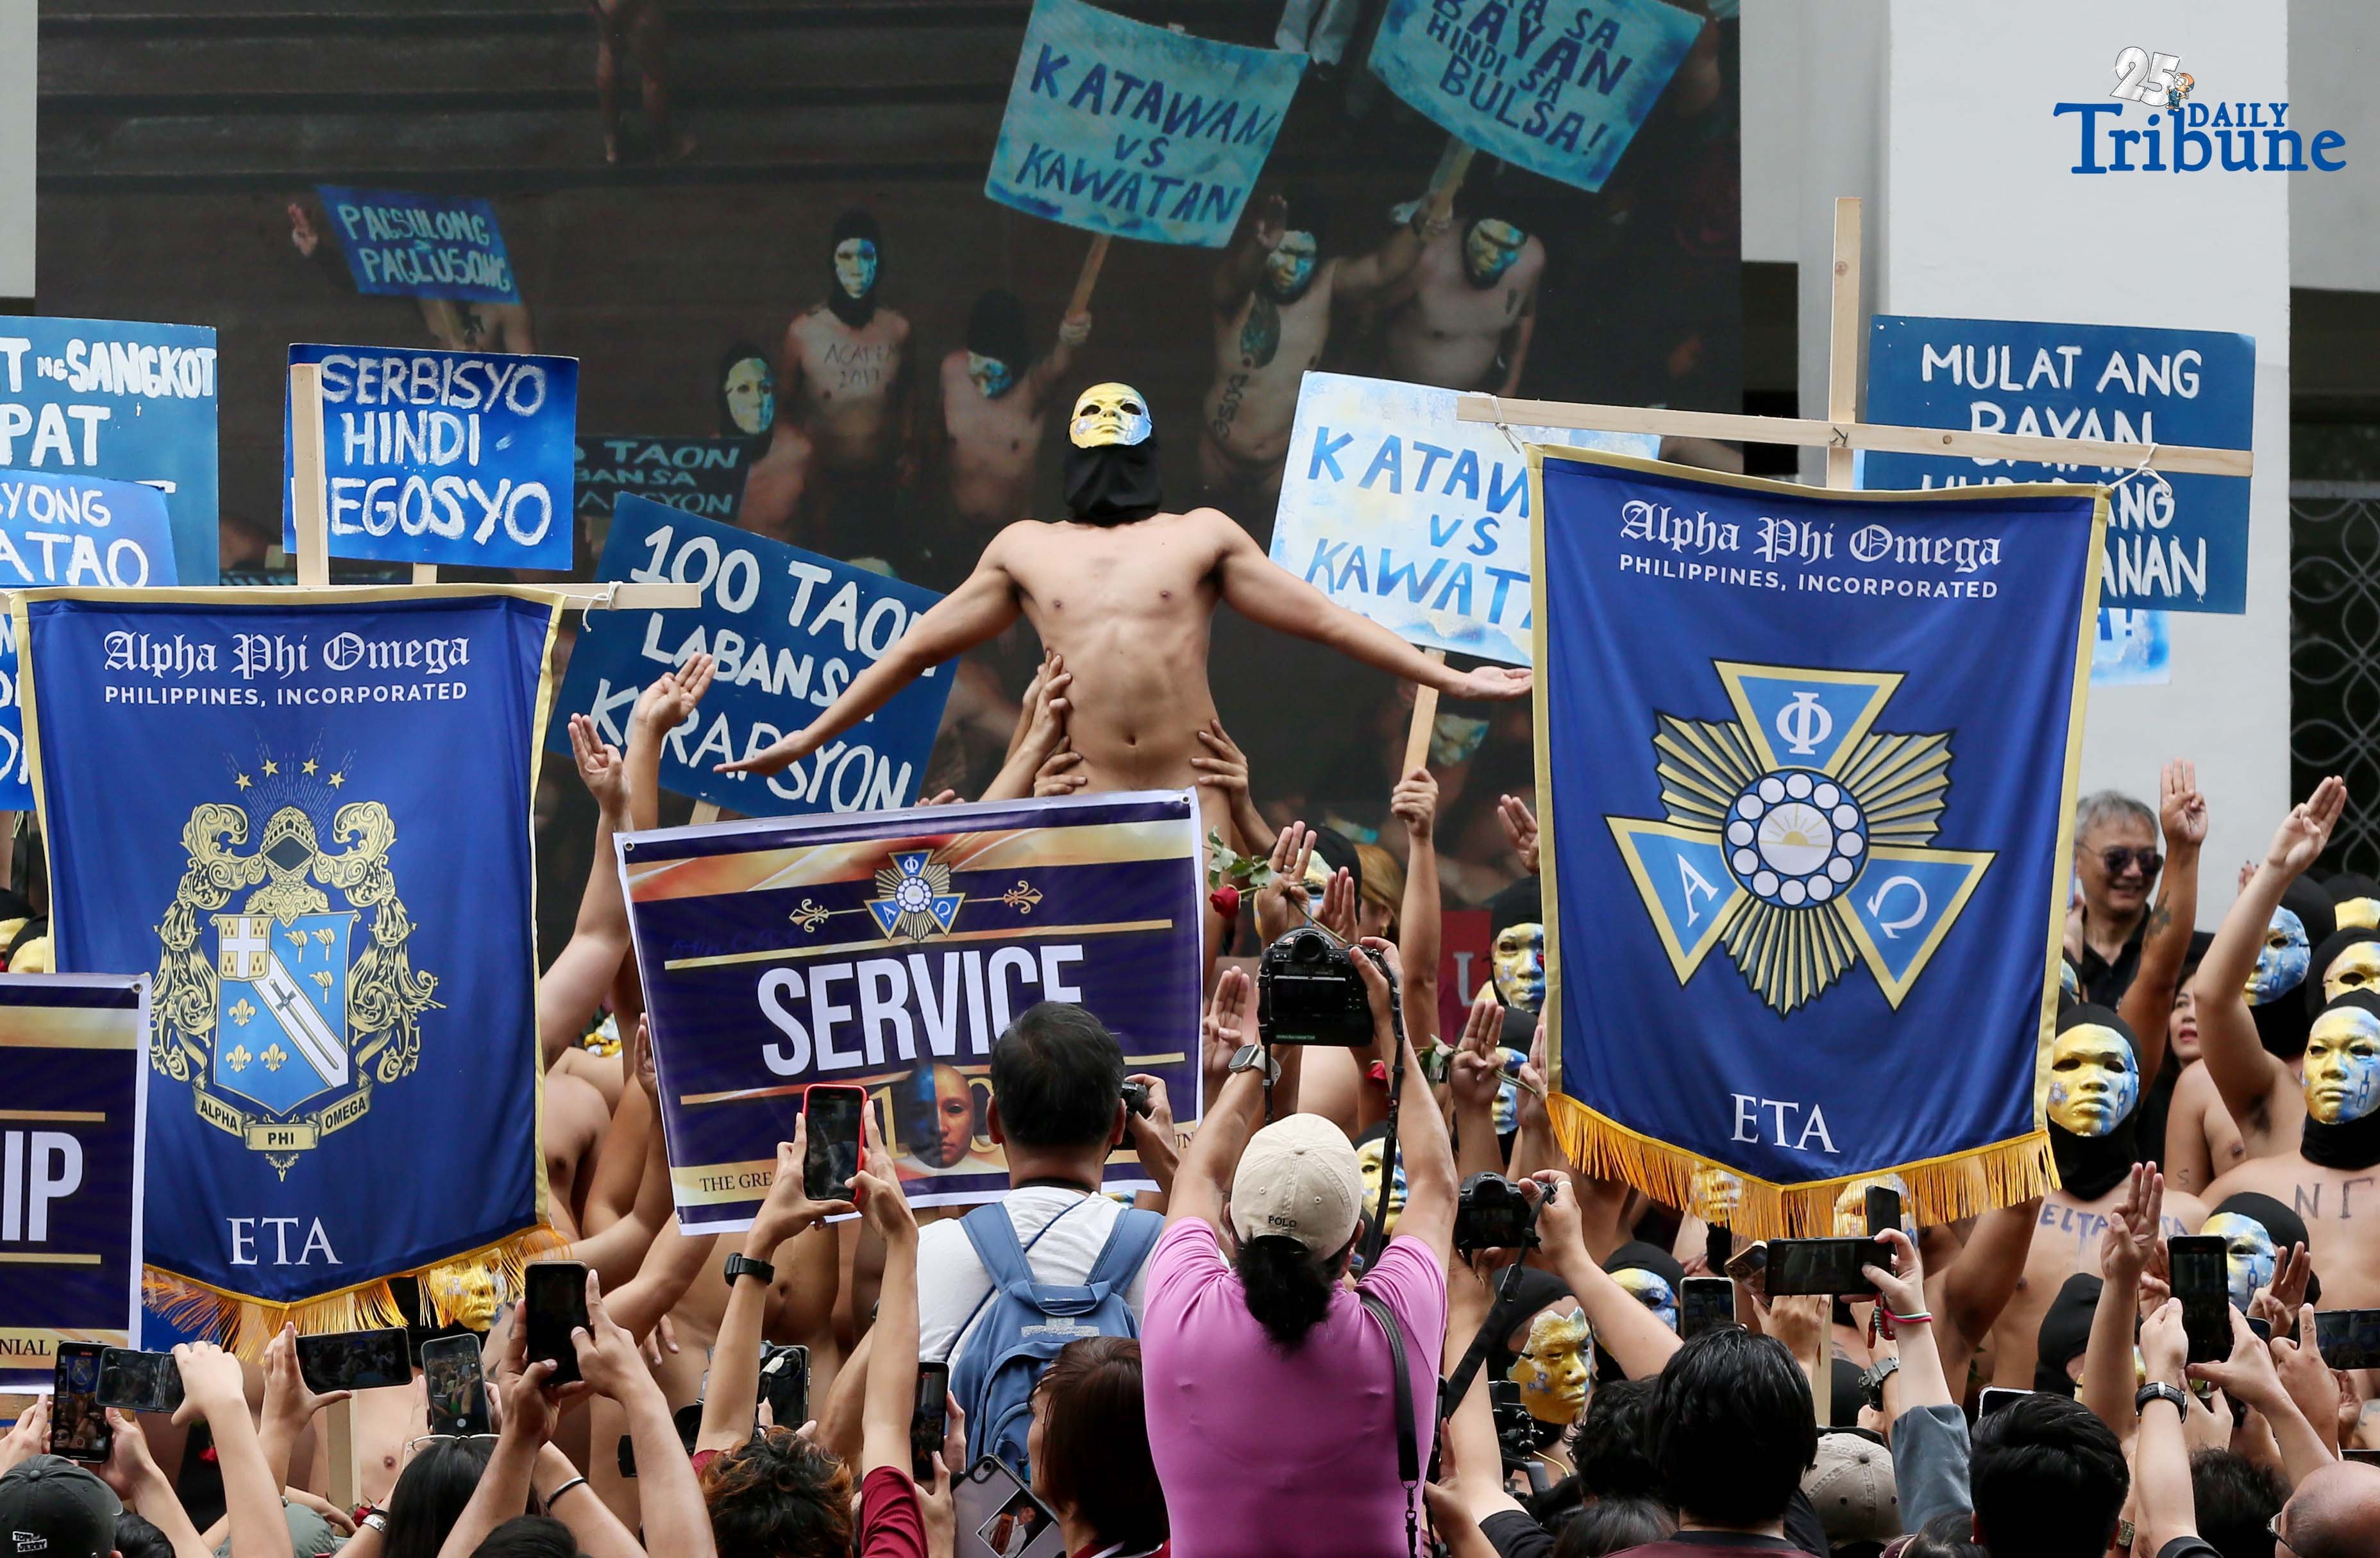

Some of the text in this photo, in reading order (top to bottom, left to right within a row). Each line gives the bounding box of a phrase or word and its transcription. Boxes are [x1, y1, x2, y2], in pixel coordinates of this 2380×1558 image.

[1426, 13, 1508, 78] HINDI
[1564, 8, 1621, 50] SA
[1031, 43, 1278, 146] KATAWAN
[1440, 53, 1610, 156] BULSA!
[1015, 142, 1242, 223] KAWATAN
[66, 339, 217, 399] SANGKOT
[320, 354, 547, 416] SERBISYO
[1922, 343, 2202, 399] MULAT ANG
[341, 411, 480, 466] HINDI
[604, 440, 740, 469] TAON
[0, 482, 112, 527] YONG
[292, 474, 553, 547] EGOSYO
[1620, 499, 2002, 574] Alpha Phi Omega
[630, 525, 761, 614] 100
[1305, 538, 1532, 630] KAWAT
[1619, 555, 1999, 600] PHILIPPINES, INCORPORATED
[104, 630, 471, 680] Alpha Phi Omega
[105, 682, 468, 708] PHILIPPINES, INCORPORATED
[589, 677, 912, 813] KRAPSYON
[200, 1096, 366, 1145] ALPHA PHI OMEGA
[1731, 1093, 1841, 1155] ETA
[700, 1176, 735, 1193] THE
[226, 1216, 343, 1266] ETA
[1268, 1215, 1297, 1228] POLO
